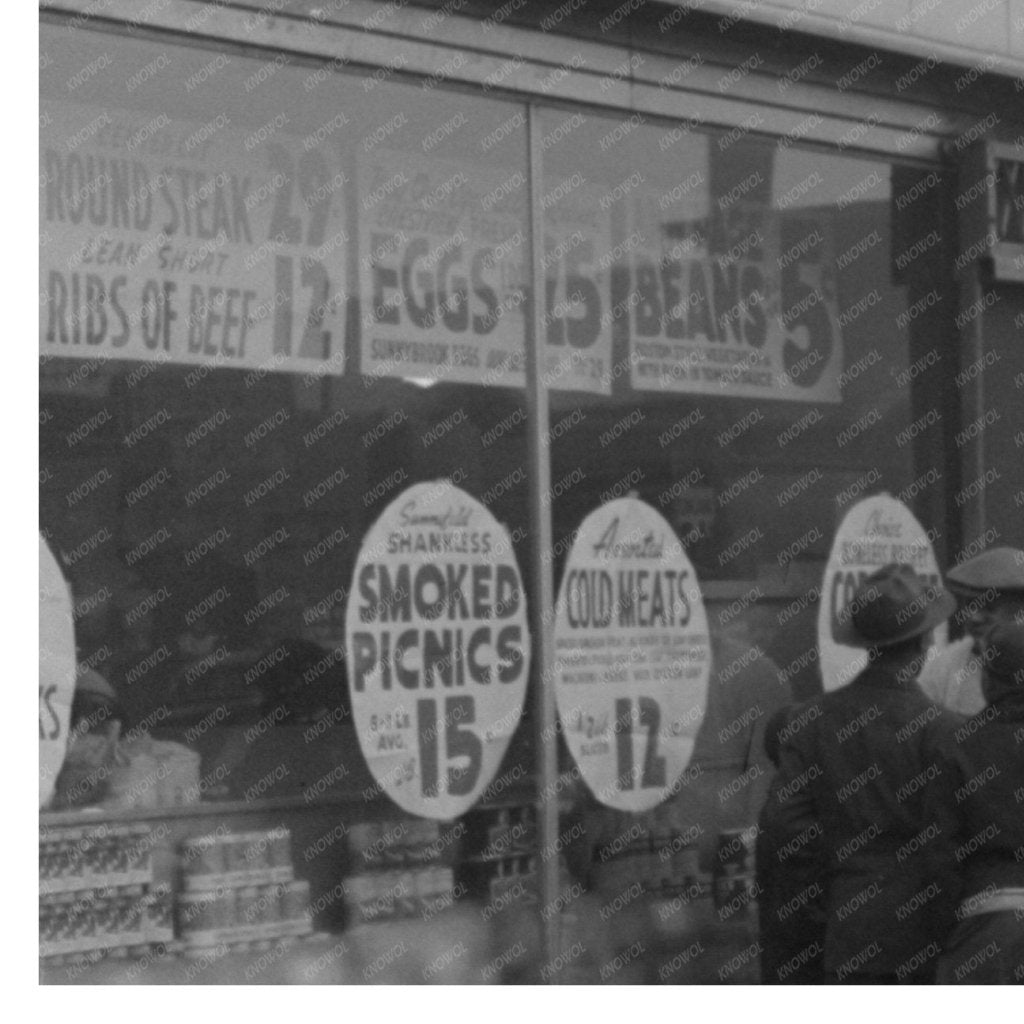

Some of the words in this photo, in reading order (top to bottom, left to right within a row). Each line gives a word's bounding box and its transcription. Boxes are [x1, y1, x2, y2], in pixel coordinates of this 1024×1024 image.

[45, 148, 153, 232] ROUND
[159, 166, 254, 246] STEAK
[81, 237, 142, 267] LEAN
[158, 244, 230, 276] SHORT
[370, 231, 500, 337] EGGS
[45, 268, 131, 349] RIBS
[140, 277, 178, 353] OF
[187, 283, 258, 360] BEEF
[634, 257, 768, 349] BEANS
[387, 531, 492, 556] SHANKLESS
[357, 562, 521, 625] SMOKED
[565, 567, 614, 630] COLD
[616, 567, 693, 629] MEATS
[349, 624, 526, 694] PICNICS
[415, 693, 484, 799] 15
[613, 695, 668, 793] 12
